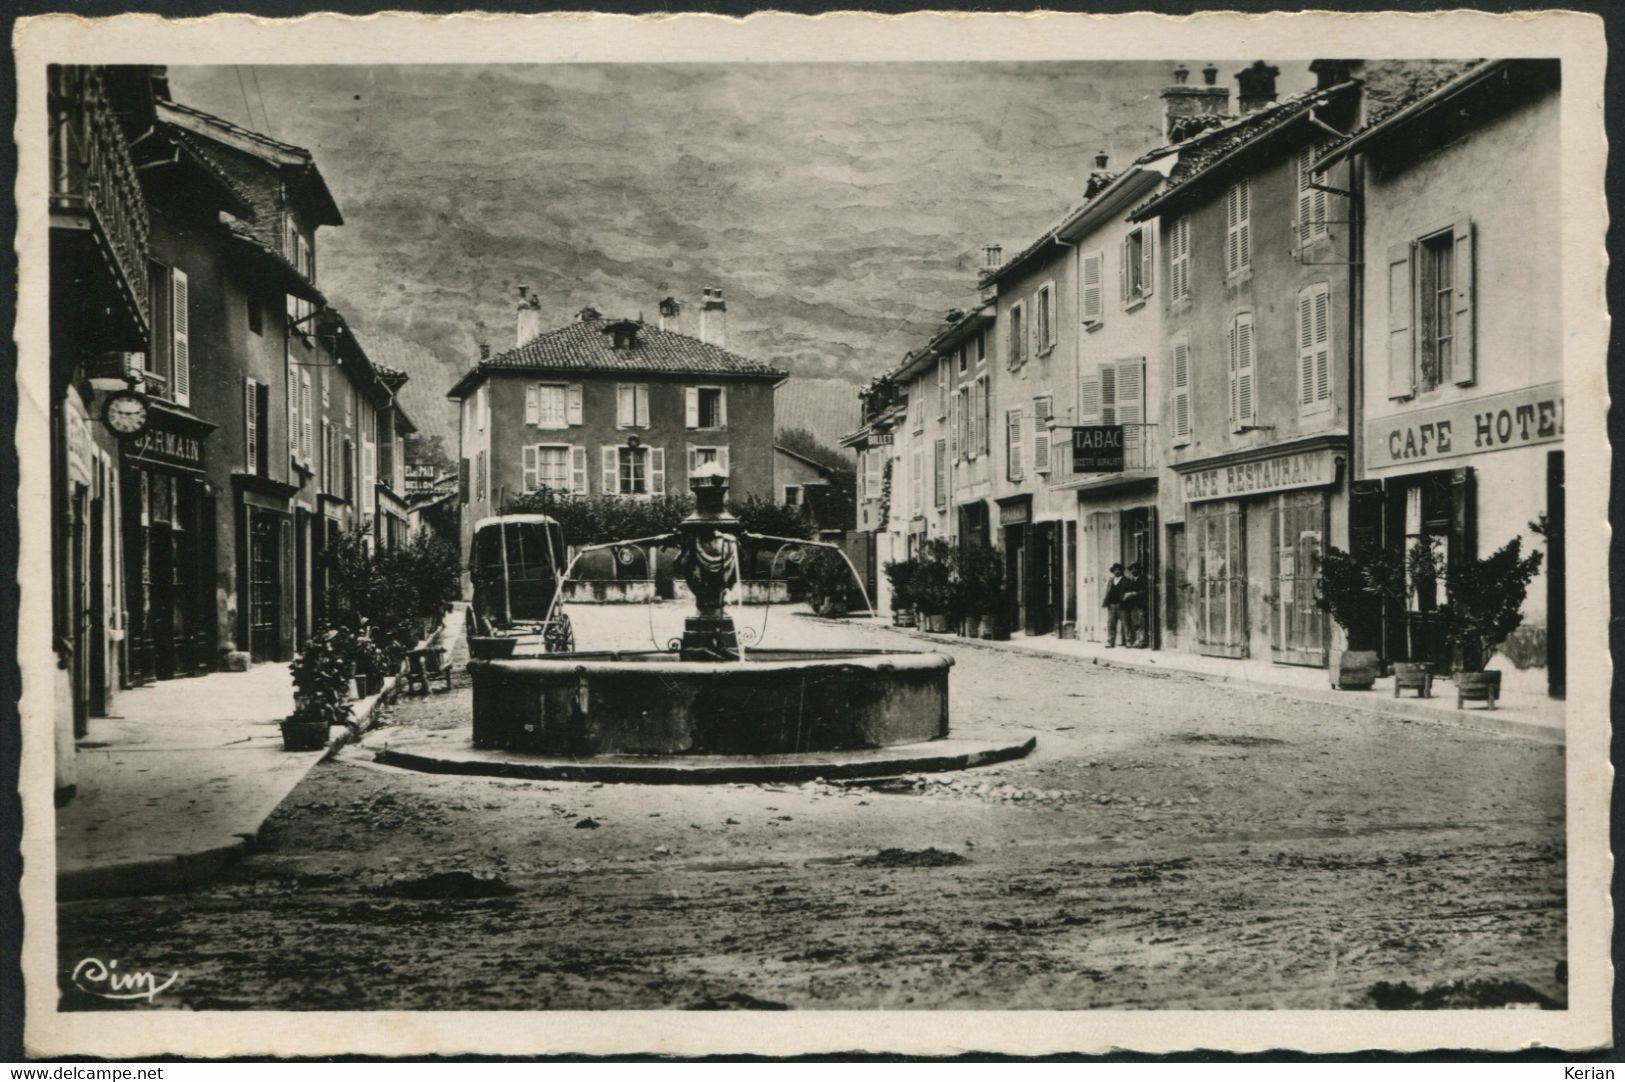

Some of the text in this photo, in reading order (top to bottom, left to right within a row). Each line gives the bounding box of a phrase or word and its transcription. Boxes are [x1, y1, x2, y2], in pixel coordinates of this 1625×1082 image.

[1073, 430, 1122, 448] TABAC
[1388, 420, 1452, 460] CAFE
[1184, 452, 1327, 499] CAFE RESTAURANT
